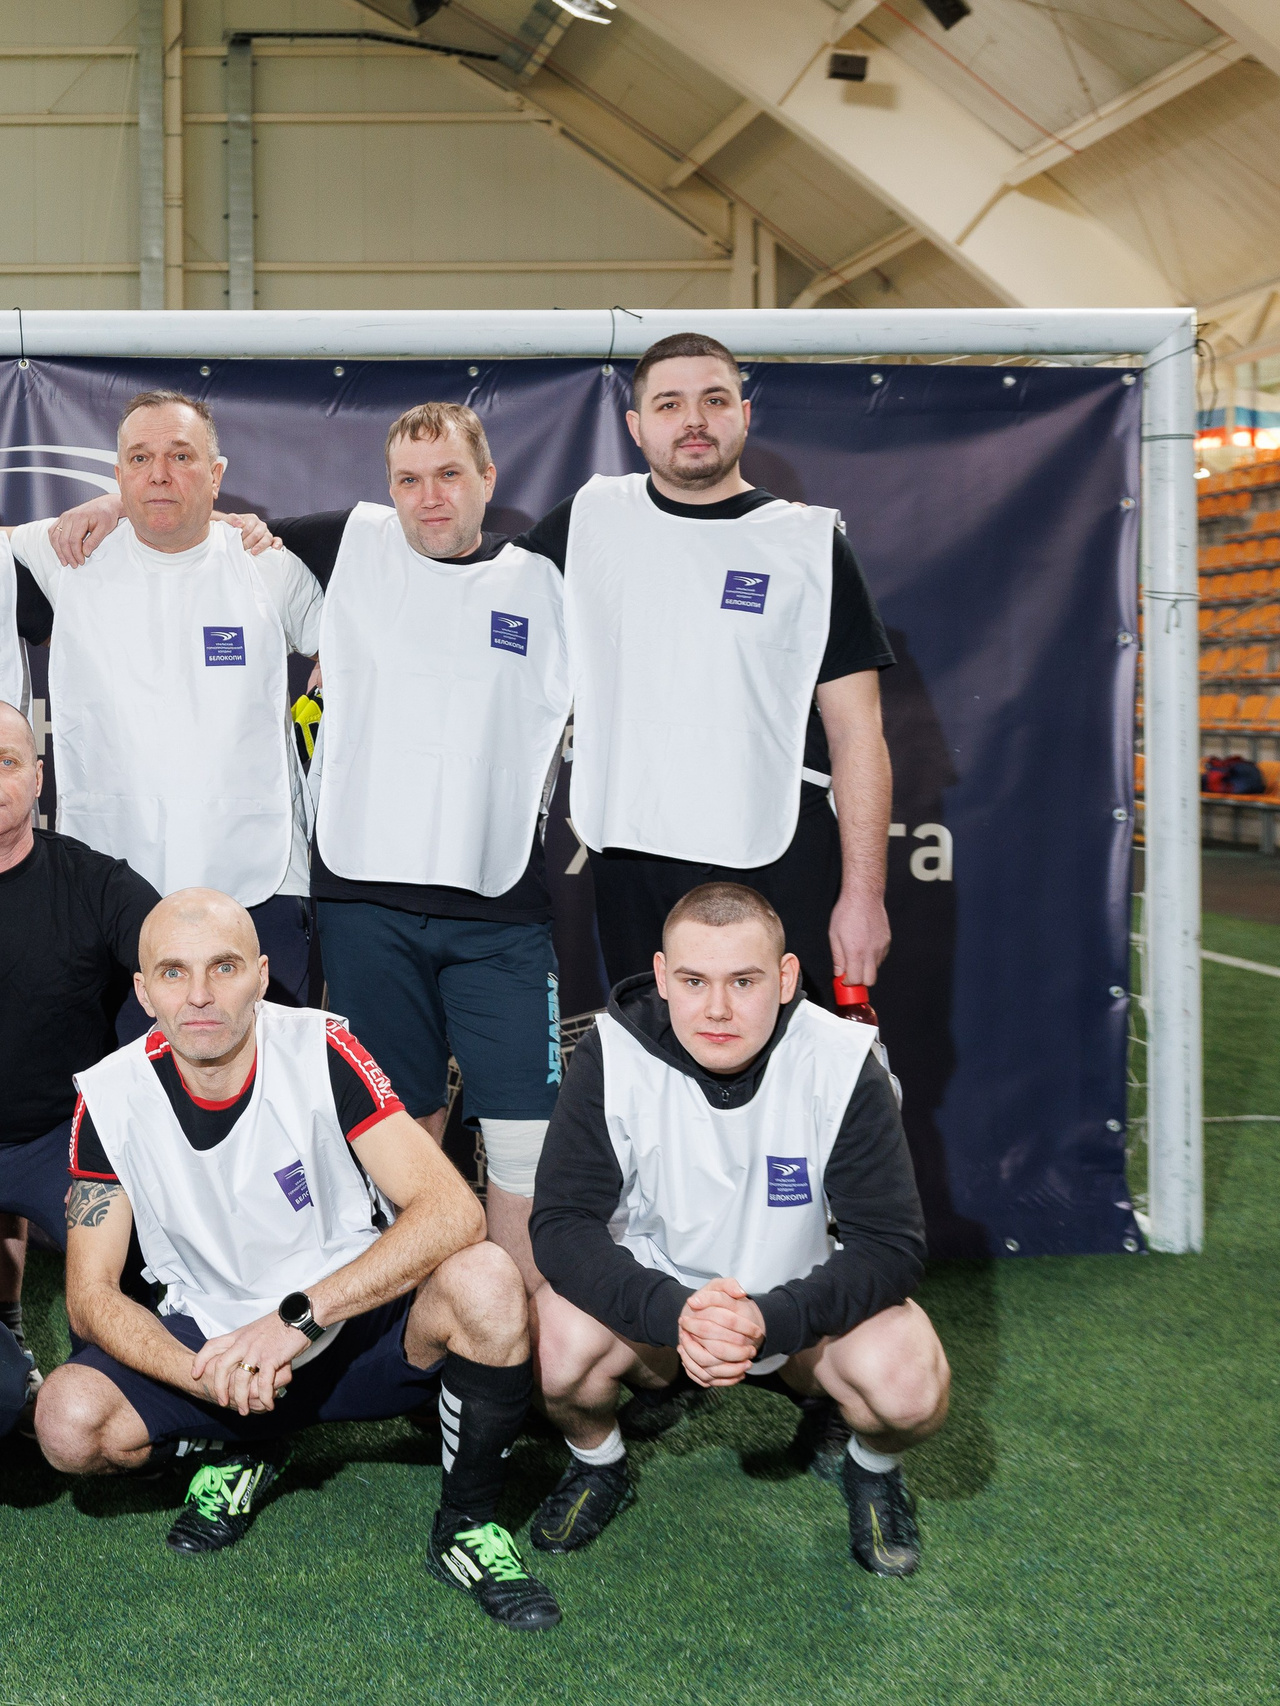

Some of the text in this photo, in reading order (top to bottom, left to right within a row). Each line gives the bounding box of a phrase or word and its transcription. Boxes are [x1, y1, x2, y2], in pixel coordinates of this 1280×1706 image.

[725, 598, 761, 608] БЕЛОКОПИ
[494, 638, 525, 650] БЕЛОКОПИ
[769, 1193, 808, 1202] БЕЛОКОПИ
